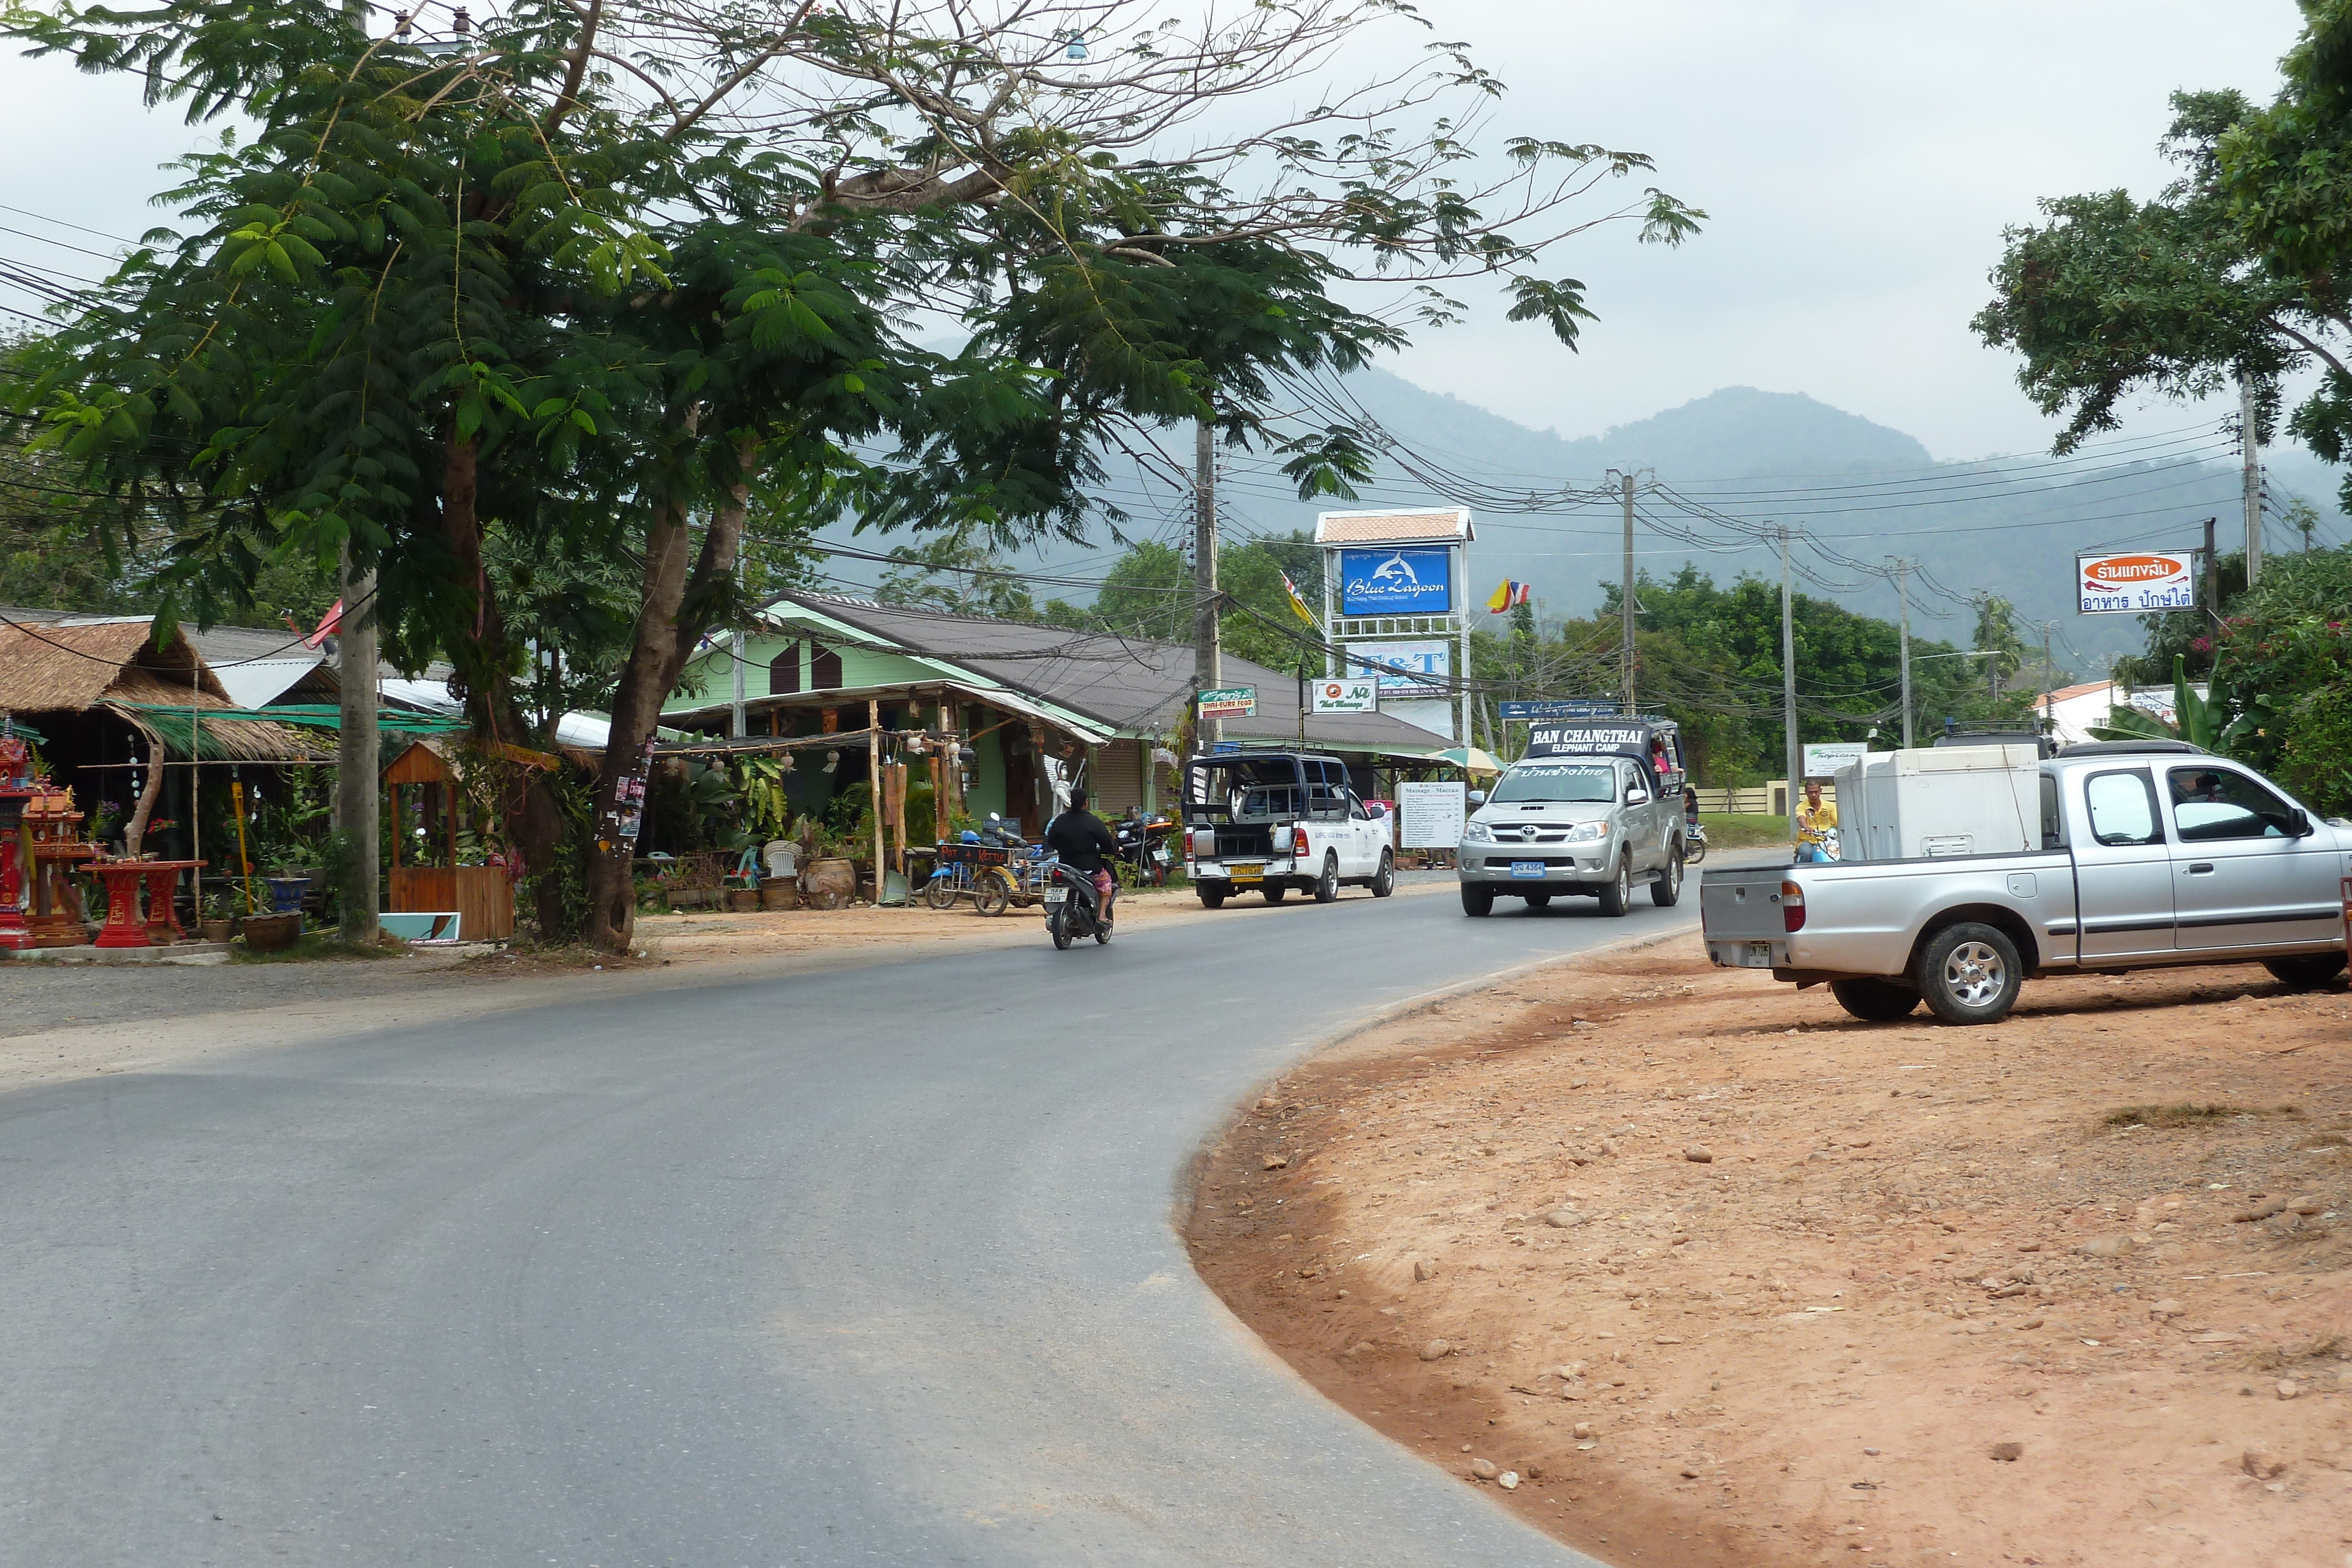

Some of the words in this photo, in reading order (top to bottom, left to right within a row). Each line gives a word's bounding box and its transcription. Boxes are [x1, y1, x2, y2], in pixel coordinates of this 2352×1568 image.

[2097, 560, 2169, 579] ร้านแกงส้ม
[1347, 578, 1385, 596] Blue
[1388, 578, 1444, 597] Lagoon
[2082, 596, 2129, 610] อาหาร
[2139, 587, 2191, 607] ปักษ์ใต้
[1532, 730, 1561, 745] BAN
[1563, 729, 1644, 744] CHANGTHAI
[1552, 743, 1594, 753] ELEPHANT
[1595, 743, 1620, 753] CAMP
[1521, 765, 1609, 777] บ้านช้างไทย
